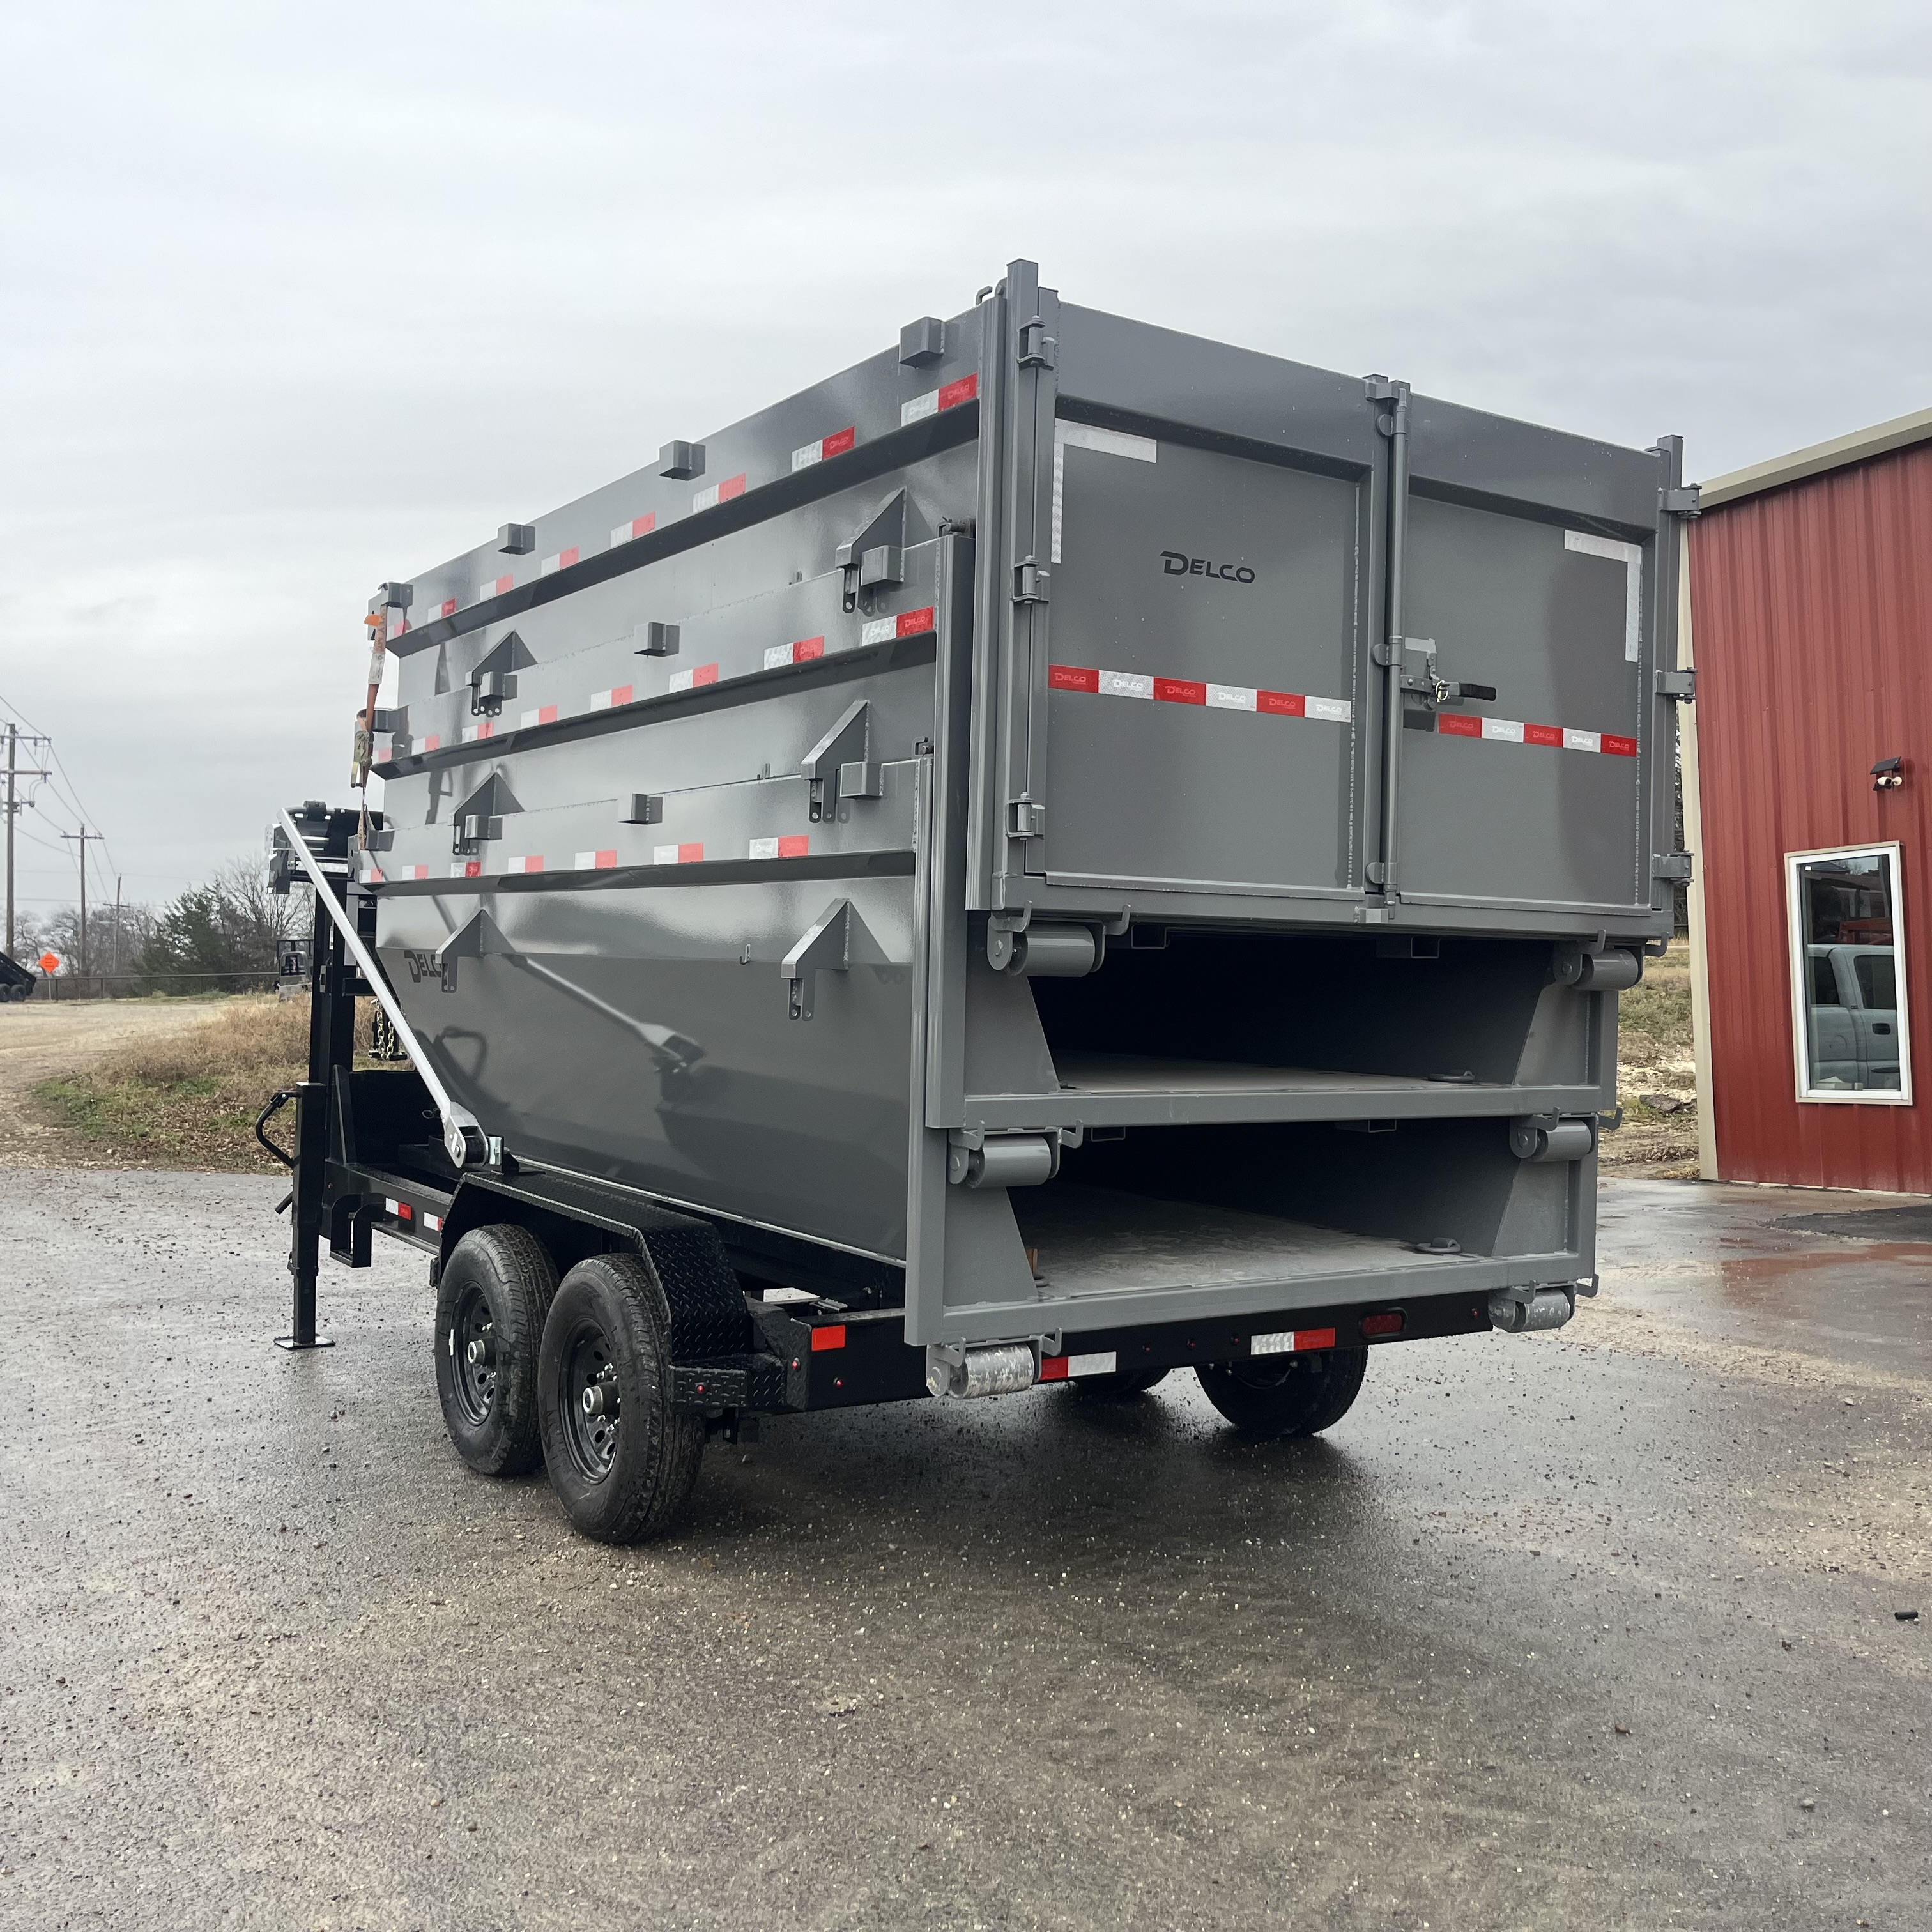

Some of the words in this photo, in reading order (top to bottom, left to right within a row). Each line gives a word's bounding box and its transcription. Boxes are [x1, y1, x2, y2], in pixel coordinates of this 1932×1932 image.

[1160, 551, 1255, 584] DELCO
[1054, 672, 1087, 683] DELCO
[1112, 679, 1144, 689] DELCO
[1165, 686, 1196, 696] DELCO
[1218, 692, 1246, 702] DELCO
[1269, 698, 1296, 707] DELCO
[1316, 704, 1343, 713] DELCO
[1449, 721, 1474, 730] DELCO
[1492, 725, 1515, 735] DELCO
[1533, 730, 1556, 739] DELCO
[1571, 735, 1593, 744] DELCO
[1609, 740, 1630, 749] DELCO
